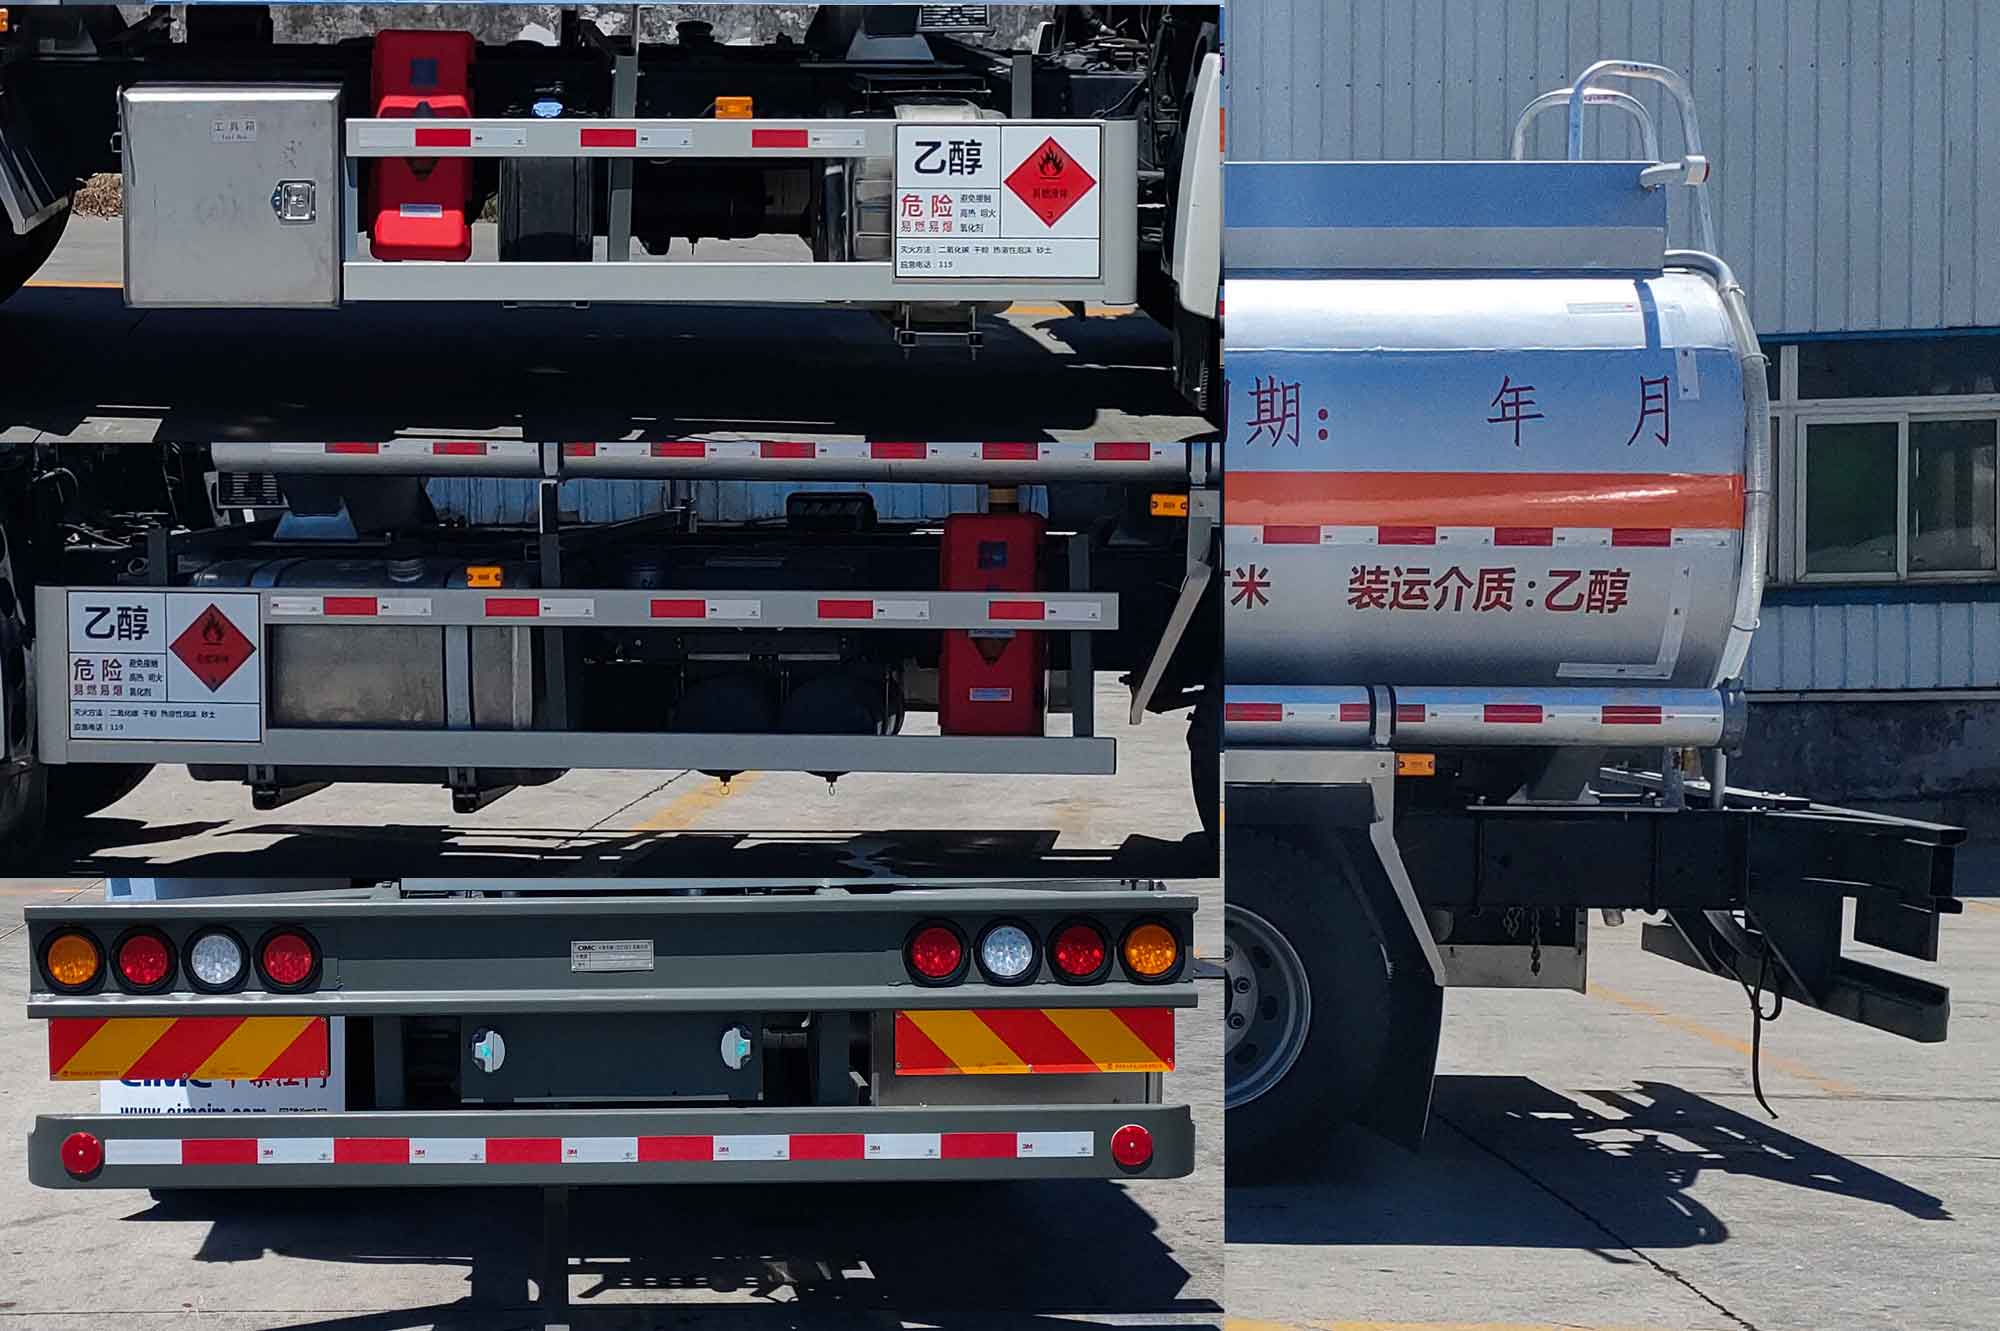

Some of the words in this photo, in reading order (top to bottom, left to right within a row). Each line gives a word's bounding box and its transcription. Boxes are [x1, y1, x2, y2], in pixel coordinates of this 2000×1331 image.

[914, 139, 982, 176] 乙醇
[901, 193, 953, 218] 危险
[1224, 375, 1329, 447] 期：
[1487, 375, 1545, 447] 年
[1627, 375, 1670, 447] 月
[1224, 564, 1271, 610] 米
[84, 605, 149, 641] 乙醇
[73, 658, 122, 682] 危险
